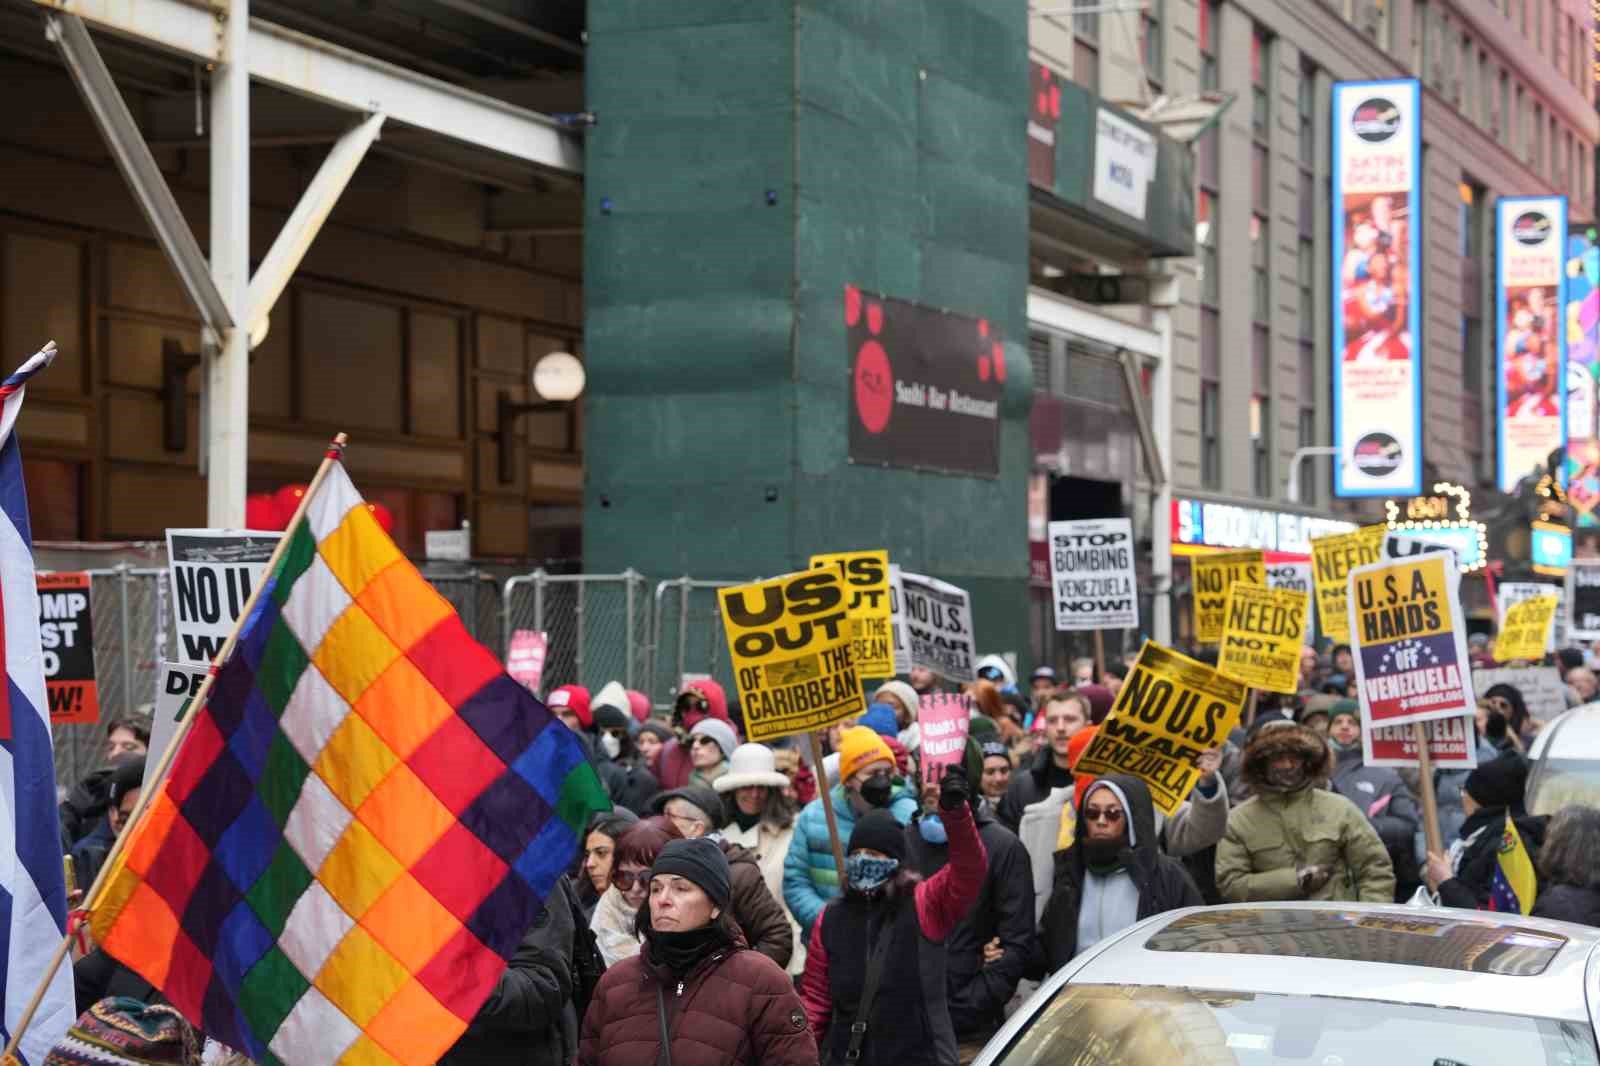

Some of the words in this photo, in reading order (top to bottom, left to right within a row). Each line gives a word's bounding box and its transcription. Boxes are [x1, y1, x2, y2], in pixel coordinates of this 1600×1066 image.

[928, 386, 948, 410] Bar
[1054, 533, 1127, 547] STOP
[1056, 547, 1128, 572] BOMBING
[175, 566, 221, 623] NO
[725, 572, 843, 628] US
[1058, 575, 1131, 598] VENEZUELA
[1197, 568, 1222, 593] NO
[1357, 569, 1437, 610] U.S.A.
[904, 592, 927, 623] NO
[931, 600, 967, 634] U.S.
[1060, 599, 1131, 612] NOW!
[1228, 598, 1302, 639] NEEDS
[1363, 600, 1441, 642] HANDS
[734, 612, 847, 659] OUT
[909, 624, 969, 653] WAR
[1227, 636, 1281, 653] NOT
[740, 665, 762, 691] OF
[821, 644, 854, 674] THE
[1395, 648, 1419, 672] OFF
[745, 668, 859, 721] CARIBBEAN
[1365, 664, 1463, 703] VENEZUELA
[1118, 668, 1174, 725] NO
[1165, 689, 1228, 749] U.S.
[1086, 735, 1193, 798] VENEZUELA
